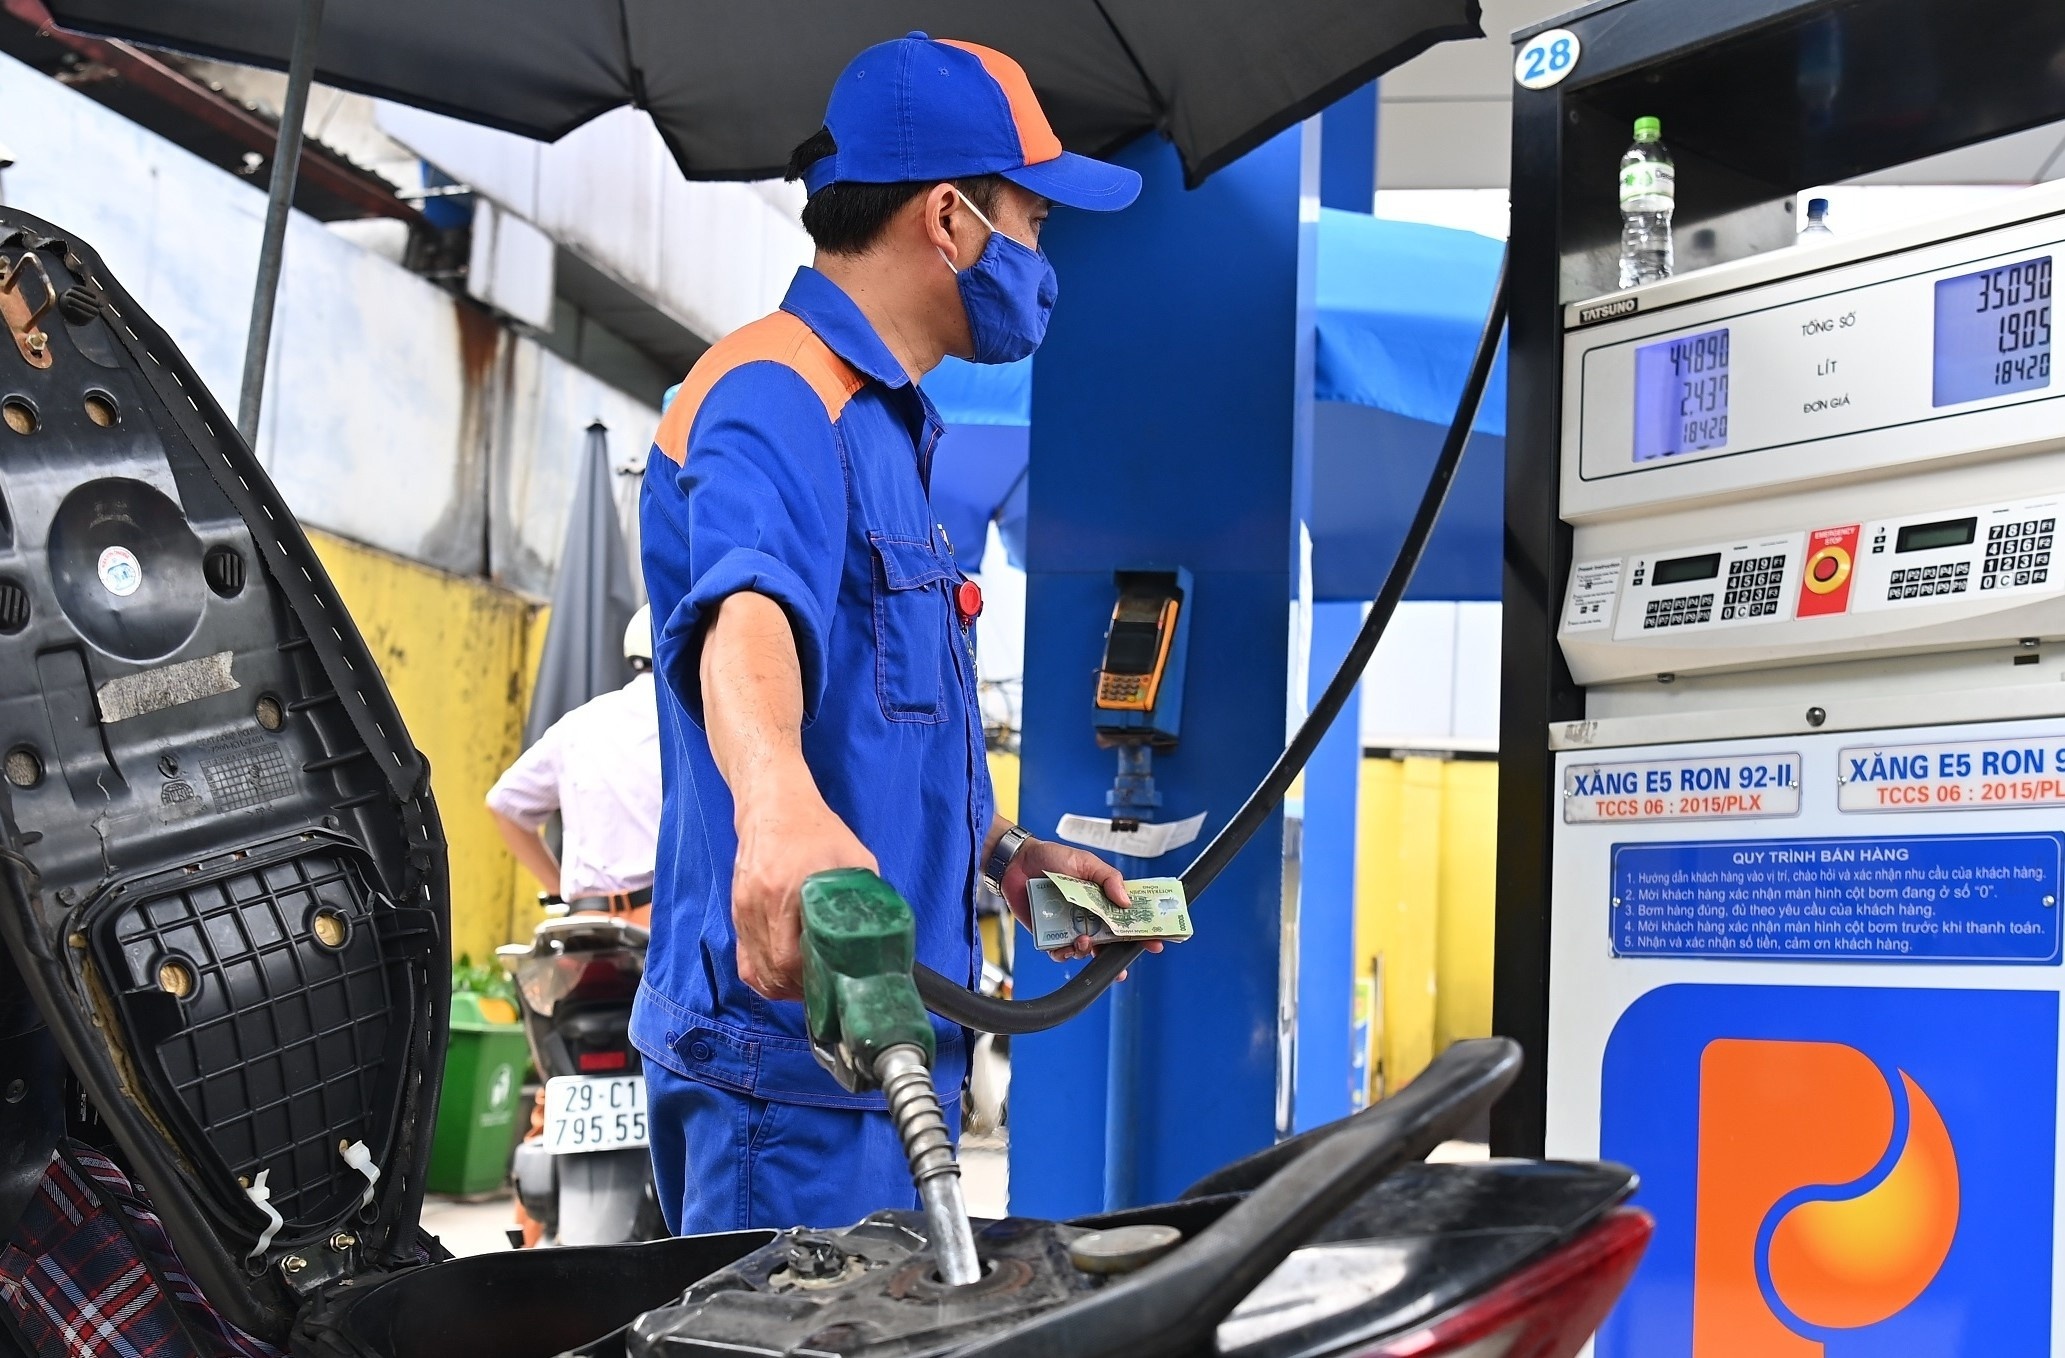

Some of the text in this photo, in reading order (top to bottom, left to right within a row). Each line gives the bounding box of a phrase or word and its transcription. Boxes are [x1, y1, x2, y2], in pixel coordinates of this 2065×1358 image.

[1524, 39, 1570, 80] 28
[1977, 261, 2052, 313] 35090
[1582, 300, 1635, 321] TATSUNO
[1839, 311, 1856, 328] SỐ
[1670, 333, 1728, 376] 44890
[1818, 358, 1837, 376] LÍT
[1995, 353, 2050, 385] 18420
[1680, 374, 1728, 416] 2.437
[1804, 393, 1850, 413] ĐƠN GIÁ
[1683, 415, 1727, 443] 18420
[1992, 527, 2001, 539] 7
[2008, 524, 2018, 537] 8
[2026, 522, 2035, 534] 9
[1989, 544, 1998, 555] 4
[2006, 541, 2015, 553] 5
[2023, 539, 2032, 551] 6
[1733, 562, 1740, 573] 7
[1746, 560, 1754, 572] 8
[1761, 559, 1768, 569] 9
[1987, 560, 1994, 572] 1
[2003, 558, 2012, 570] 2
[2020, 556, 2029, 568] 3
[1730, 578, 1736, 588] 4
[1743, 576, 1751, 587] 5
[1758, 574, 1765, 585] 6
[1983, 577, 1993, 588] 0
[2001, 575, 2010, 586] C
[1741, 591, 1748, 601] 2
[1755, 589, 1762, 600] 3
[1738, 606, 1746, 617] C
[1850, 751, 1929, 782] XĂNG
[1939, 753, 1971, 778] E5
[1982, 749, 2044, 776] RON
[1574, 764, 1792, 796] XĂNG E5 RON 92-II
[1877, 786, 1929, 804] TCCS
[1937, 785, 1961, 802] 06
[1596, 800, 1638, 817] TCCS
[1644, 799, 1663, 814] 06
[1680, 794, 1761, 814] 2015/PLX
[1733, 847, 1909, 865] QUY TRÌNH BÁN HÀNG
[1638, 871, 1670, 886] Hướng
[1672, 869, 1689, 883] dẫn
[1691, 871, 1719, 883] khách
[1721, 871, 1744, 885] hàng
[1747, 871, 1764, 882] vào
[1766, 871, 1775, 884] vị
[1793, 870, 1818, 881] chào
[1820, 869, 1836, 880] hỏi
[1838, 869, 1850, 880] và
[1854, 869, 1873, 880] xác
[1875, 868, 1901, 882] nhận
[1905, 868, 1926, 880] nhu
[1928, 865, 1949, 880] cầu
[1951, 866, 1972, 879] của
[1975, 866, 2010, 879] khách
[2013, 866, 2046, 882] hàng.
[1638, 889, 1659, 900] Mời
[1662, 889, 1695, 900] khách
[1699, 888, 1725, 903] hàng
[1729, 889, 1749, 900] xác
[1752, 889, 1781, 902] nhận
[1784, 888, 1811, 900] màn
[1815, 887, 1842, 899] hình
[1845, 887, 1865, 901] cột
[1869, 886, 1898, 899] bơm
[1902, 886, 1936, 901] đang
[1939, 885, 1950, 898] ở
[1954, 882, 1971, 898] số
[1638, 904, 1664, 916] Bơm
[1667, 905, 1693, 918] hàng
[1699, 905, 1728, 918] đúng,
[1732, 904, 1746, 916] đủ
[1750, 904, 1776, 916] theo
[1779, 904, 1800, 918] yêu
[1804, 901, 1826, 916] cầu
[1830, 903, 1852, 916] của
[1856, 904, 1895, 916] khách
[1898, 903, 1935, 919] hàng.
[1046, 932, 1068, 940] 20000
[1637, 921, 1659, 932] Mời
[1661, 921, 1694, 932] khách
[1697, 921, 1725, 935] hàng
[1728, 921, 1749, 932] xác
[1752, 921, 1781, 935] nhận
[1784, 921, 1811, 933] màn
[1815, 921, 1841, 933] hình
[1845, 921, 1865, 936] cột
[1868, 921, 1898, 933] bơm
[1902, 921, 1939, 934] trước
[1942, 921, 1963, 933] khi
[1966, 921, 2006, 934] thanh
[2010, 921, 2045, 934] toán.
[1637, 936, 1666, 950] Nhận
[1669, 936, 1683, 948] và
[1685, 937, 1705, 948] xác
[1708, 936, 1738, 951] nhận
[1739, 934, 1753, 949] số
[1784, 937, 1810, 950] cảm
[1814, 939, 1831, 950] ơn
[1835, 937, 1872, 950] khách
[1877, 937, 1912, 953] hàng.
[556, 1113, 645, 1145] 795.55
